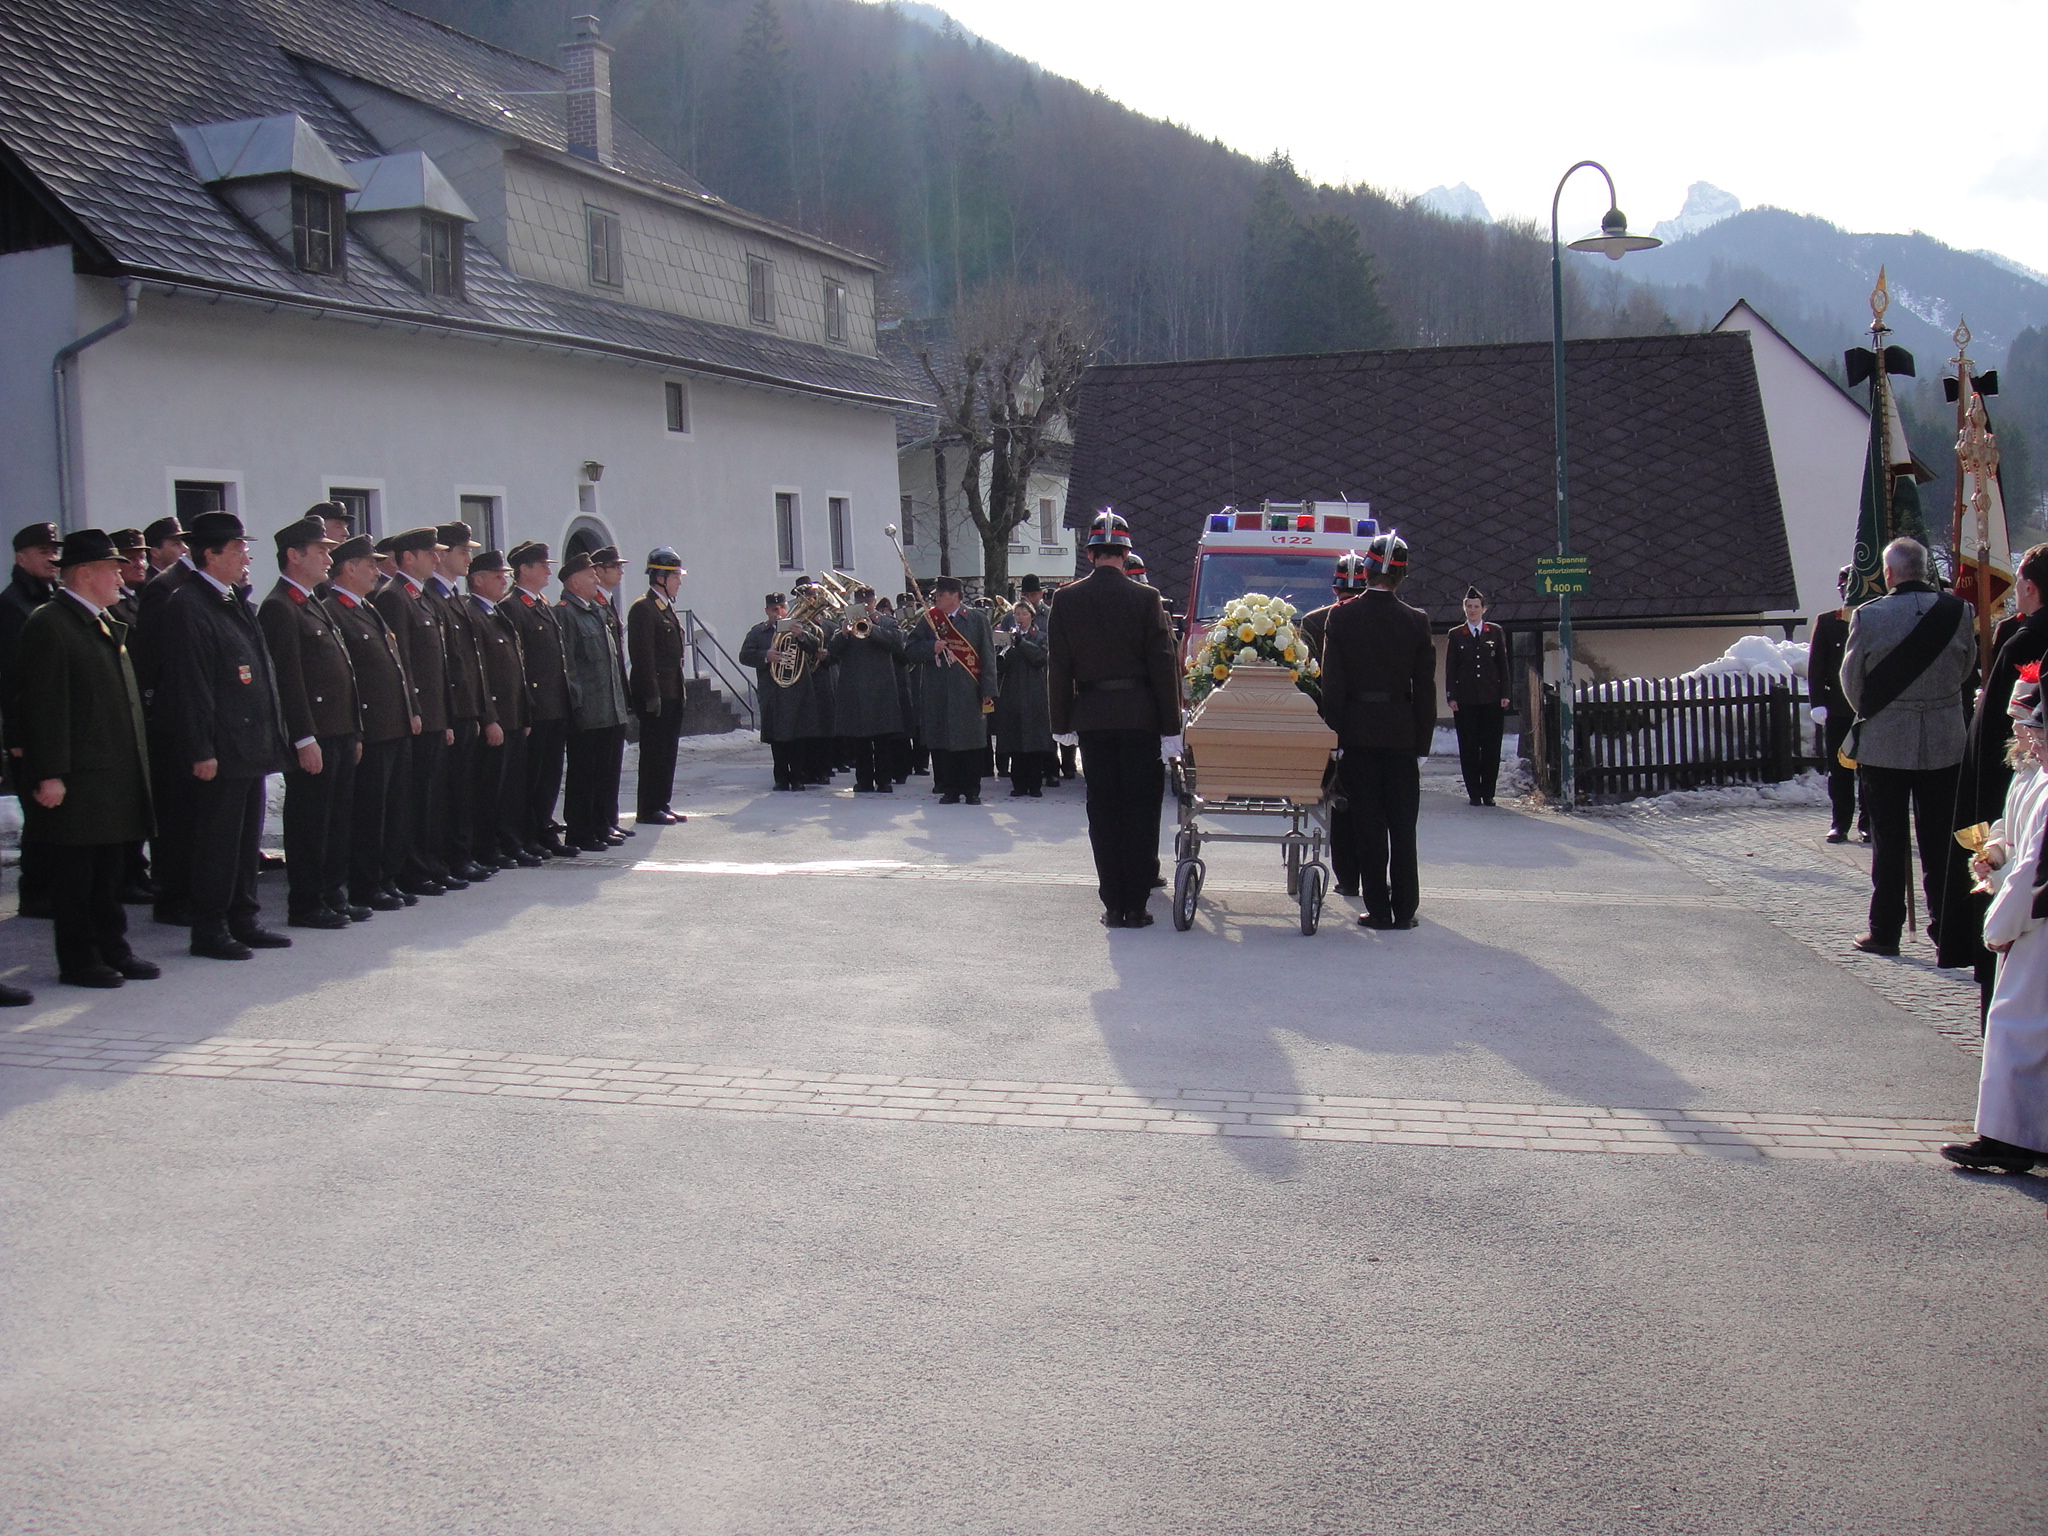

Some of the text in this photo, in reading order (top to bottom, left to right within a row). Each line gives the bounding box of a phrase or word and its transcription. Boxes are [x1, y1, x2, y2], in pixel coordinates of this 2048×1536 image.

[1278, 536, 1312, 544] 122
[1556, 556, 1587, 564] Spanner
[1553, 583, 1582, 592] 400 m
